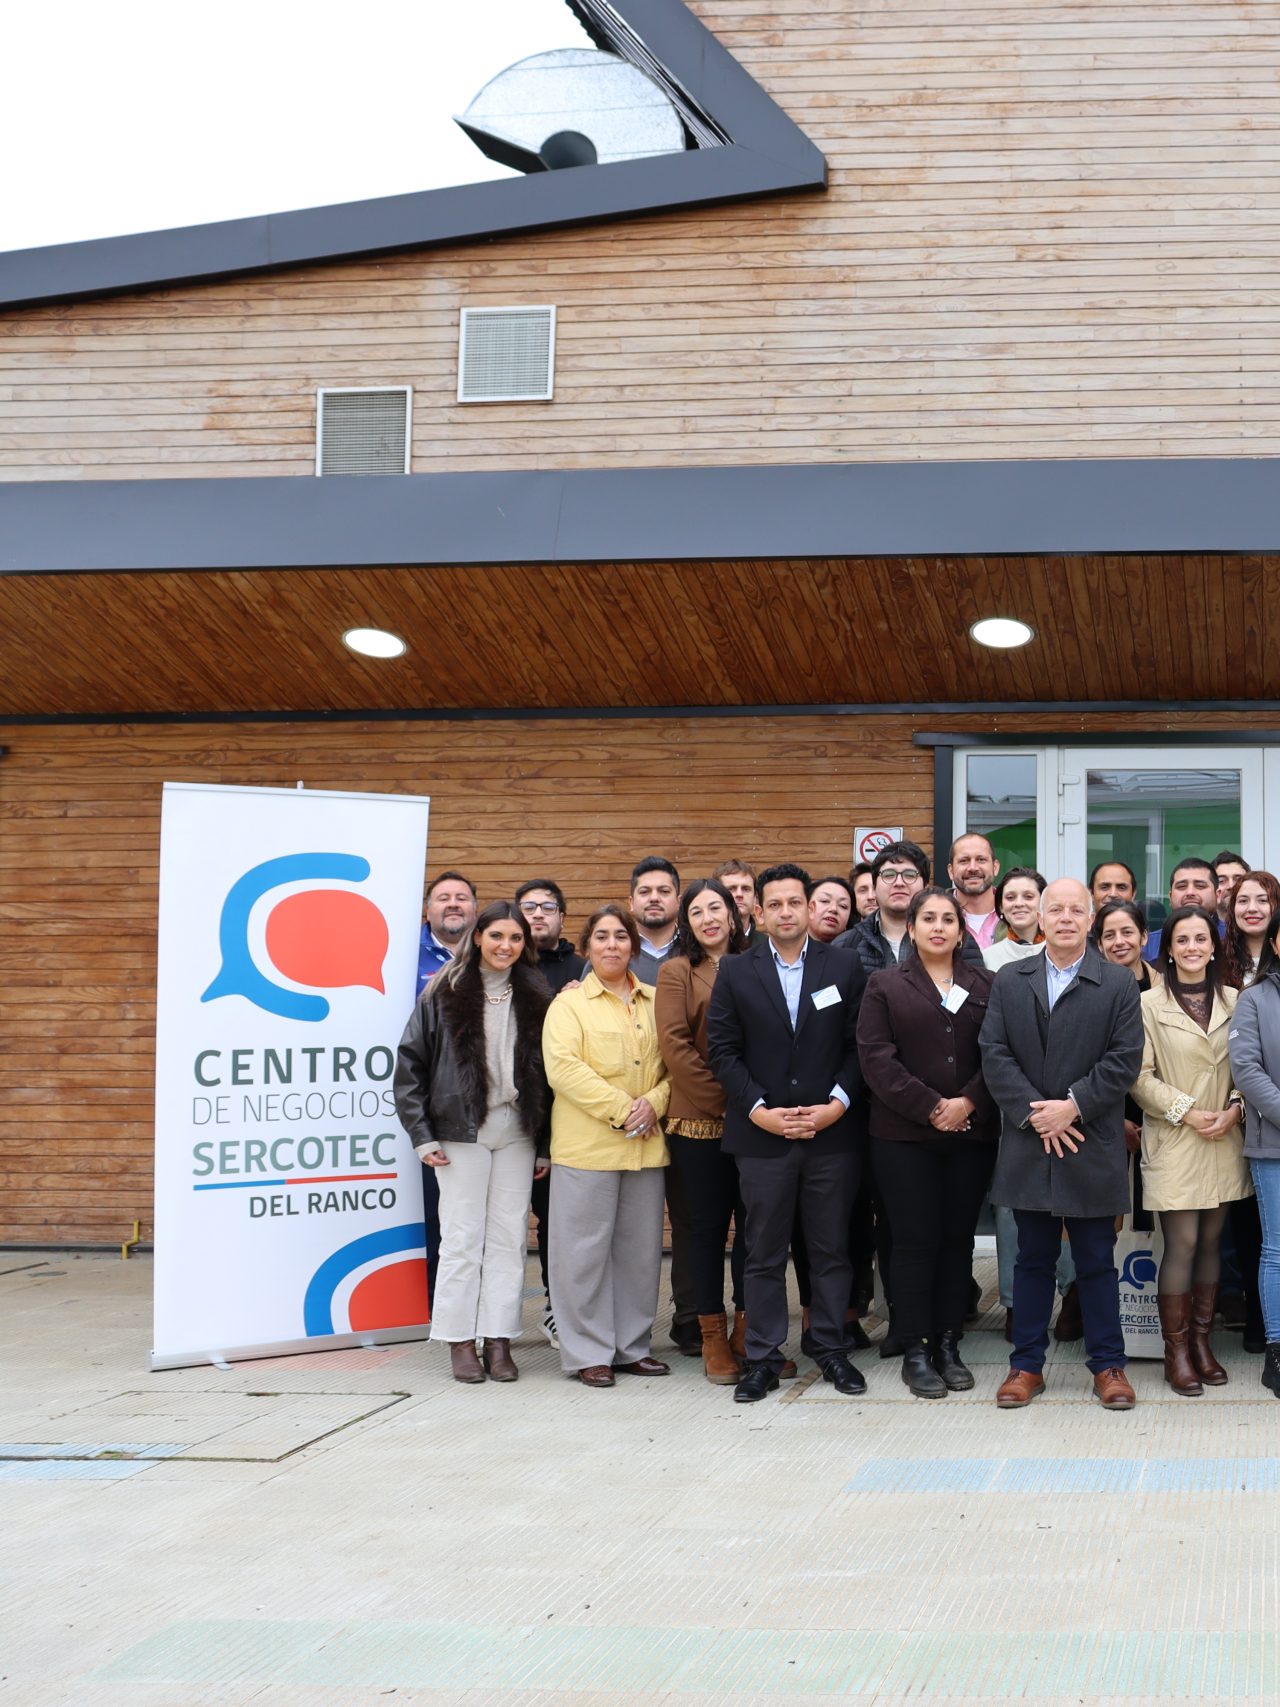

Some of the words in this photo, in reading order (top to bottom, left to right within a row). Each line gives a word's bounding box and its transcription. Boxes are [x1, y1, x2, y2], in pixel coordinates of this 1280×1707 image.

[193, 1045, 394, 1087] CENTRO
[193, 1095, 231, 1125] DE
[243, 1090, 398, 1122] NEGOCIOS
[192, 1133, 397, 1176] SERCOTEC
[249, 1194, 300, 1218] DEL
[308, 1187, 397, 1214] RANCO
[1119, 1293, 1158, 1304] ENTRO
[1120, 1314, 1159, 1324] ERCOTEC
